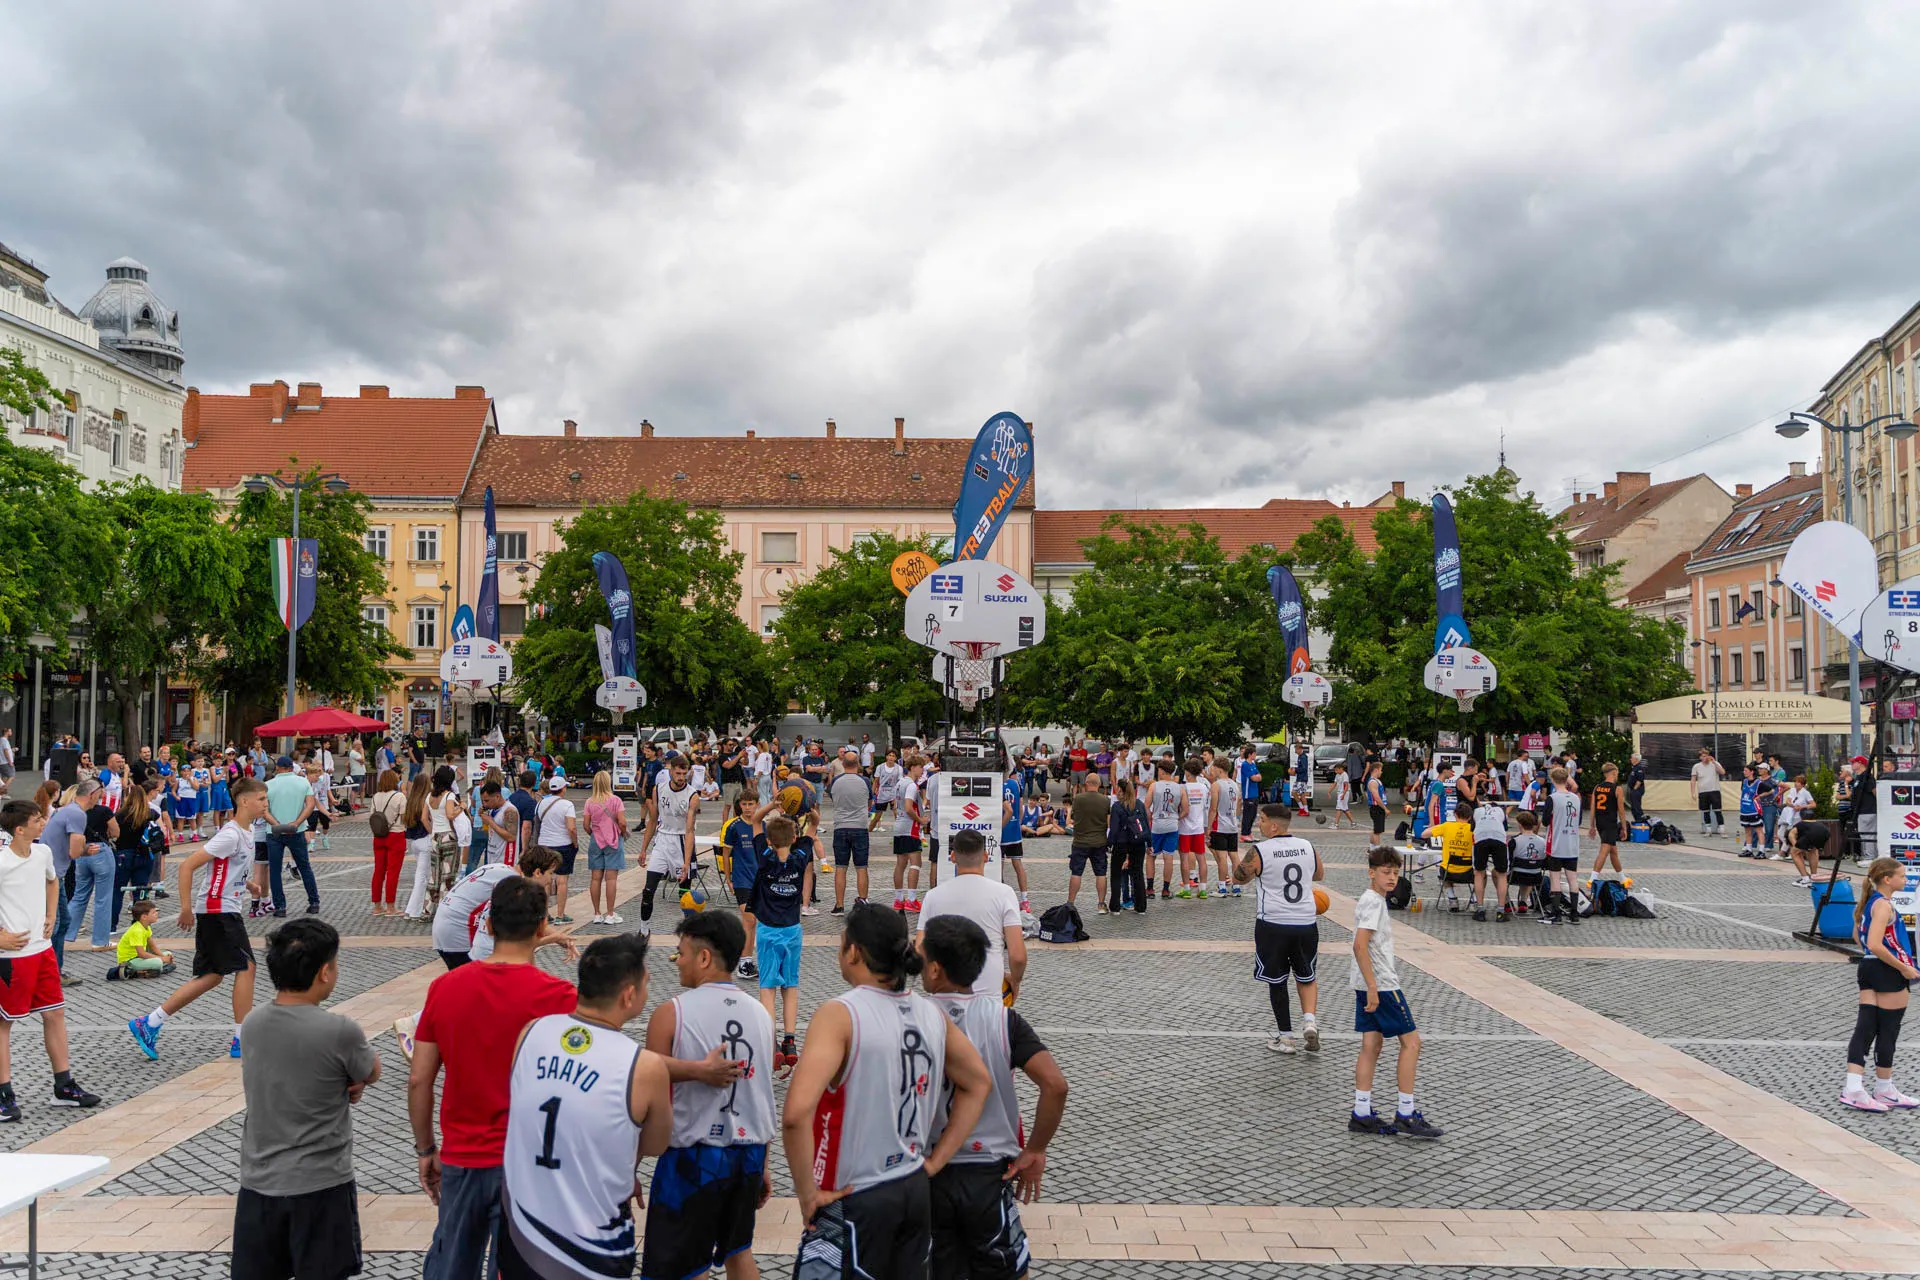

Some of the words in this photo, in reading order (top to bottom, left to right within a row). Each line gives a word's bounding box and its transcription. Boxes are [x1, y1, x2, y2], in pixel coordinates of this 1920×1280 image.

[984, 594, 1028, 603] SUZUKI
[949, 606, 959, 617] 7
[1908, 621, 1918, 633] 8
[661, 797, 670, 809] 34
[1597, 794, 1607, 810] 2
[1283, 863, 1303, 903] 8
[537, 1056, 600, 1093] SAAYO
[536, 1096, 562, 1169] 1
